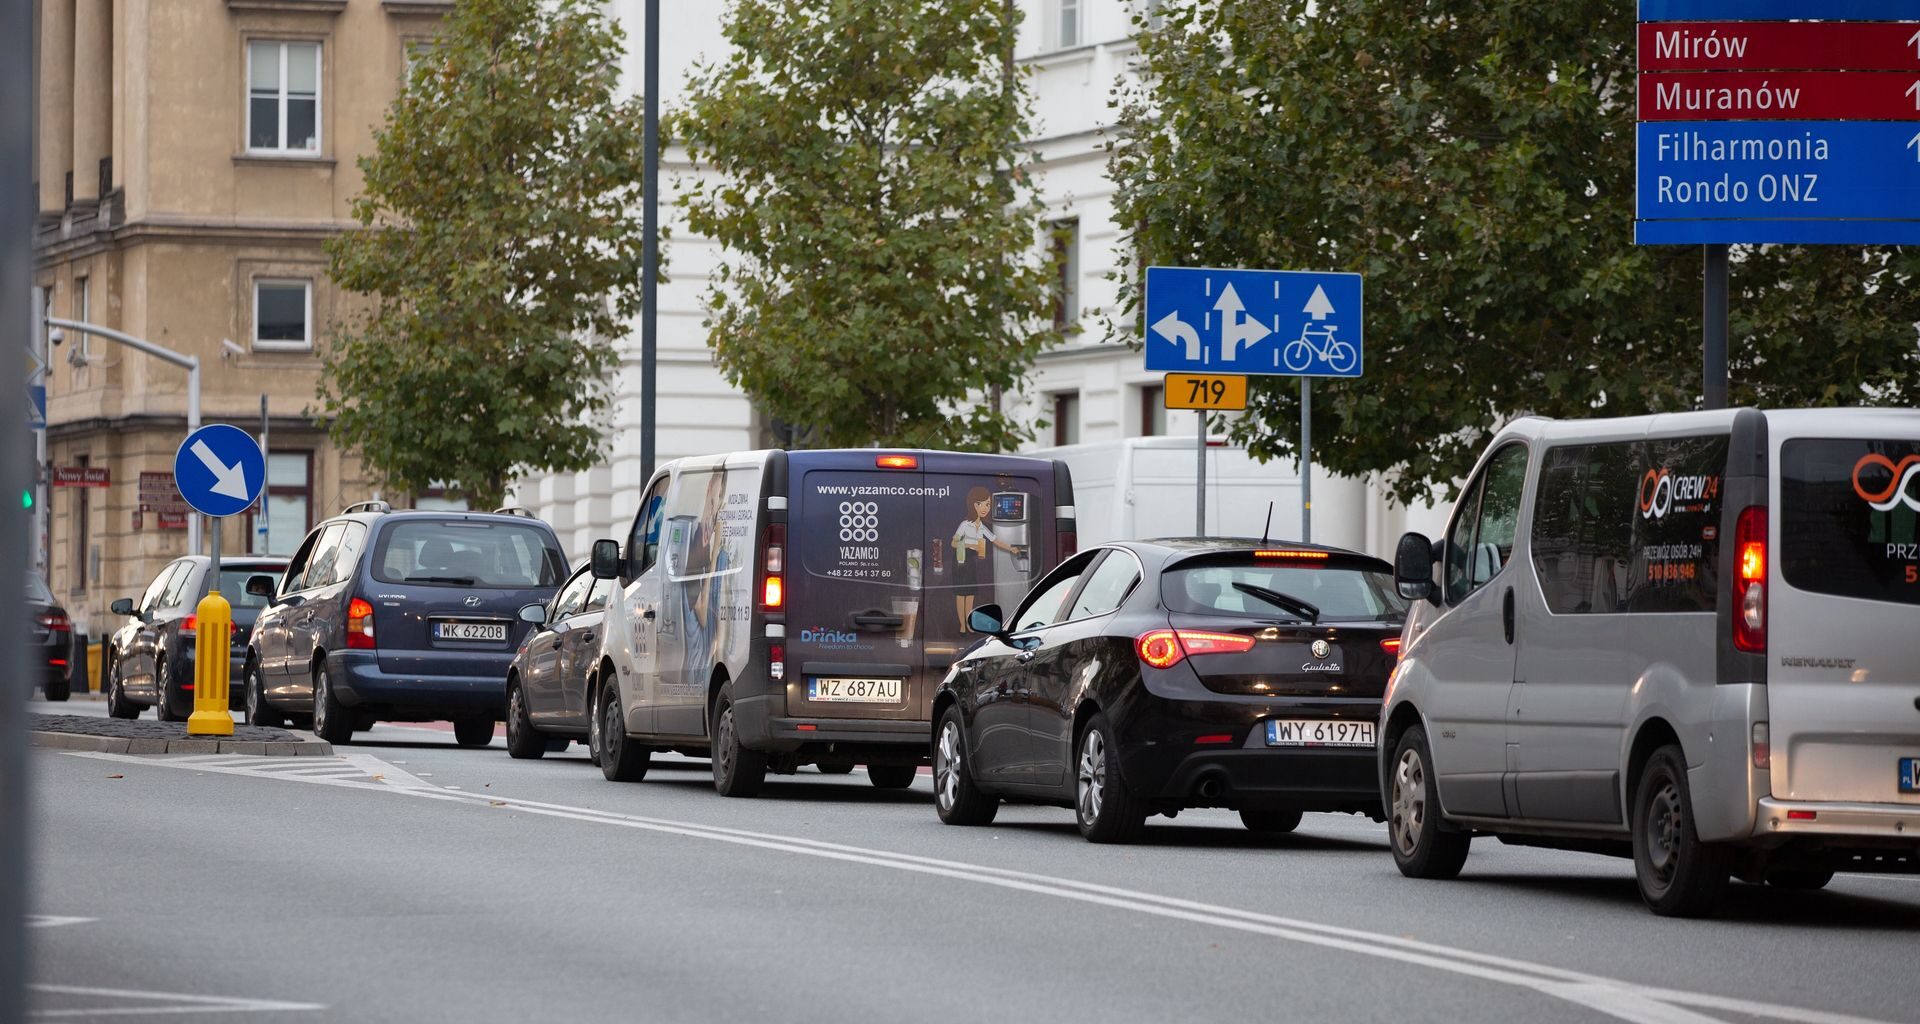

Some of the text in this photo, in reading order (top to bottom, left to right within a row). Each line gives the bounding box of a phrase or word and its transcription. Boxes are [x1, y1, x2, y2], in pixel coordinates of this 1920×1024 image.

[1655, 30, 1748, 59] Mirów
[1656, 81, 1800, 110] Muranów
[1658, 131, 1829, 161] Filharmonia
[1658, 173, 1818, 203] Rondo ONZ
[1187, 379, 1226, 404] 719
[58, 469, 81, 481] Nowy
[817, 485, 950, 499] www.yazamco.com.pl
[840, 546, 879, 560] YAZAMCO
[1670, 541, 1687, 559] OSÓB
[1688, 544, 1702, 559] 24H
[1887, 543, 1920, 559] PRZ
[827, 569, 842, 577] +48
[843, 569, 853, 577] 22
[854, 569, 868, 577] 541
[1905, 565, 1918, 583] 5
[442, 623, 503, 639] WK 62208
[801, 627, 857, 643] Drinka
[1301, 662, 1341, 672] Giulietta
[1781, 656, 1857, 669] RENAULT
[820, 680, 897, 698] WZ 687AU
[1279, 722, 1372, 742] WY 6197H
[1902, 776, 1911, 784] PL
